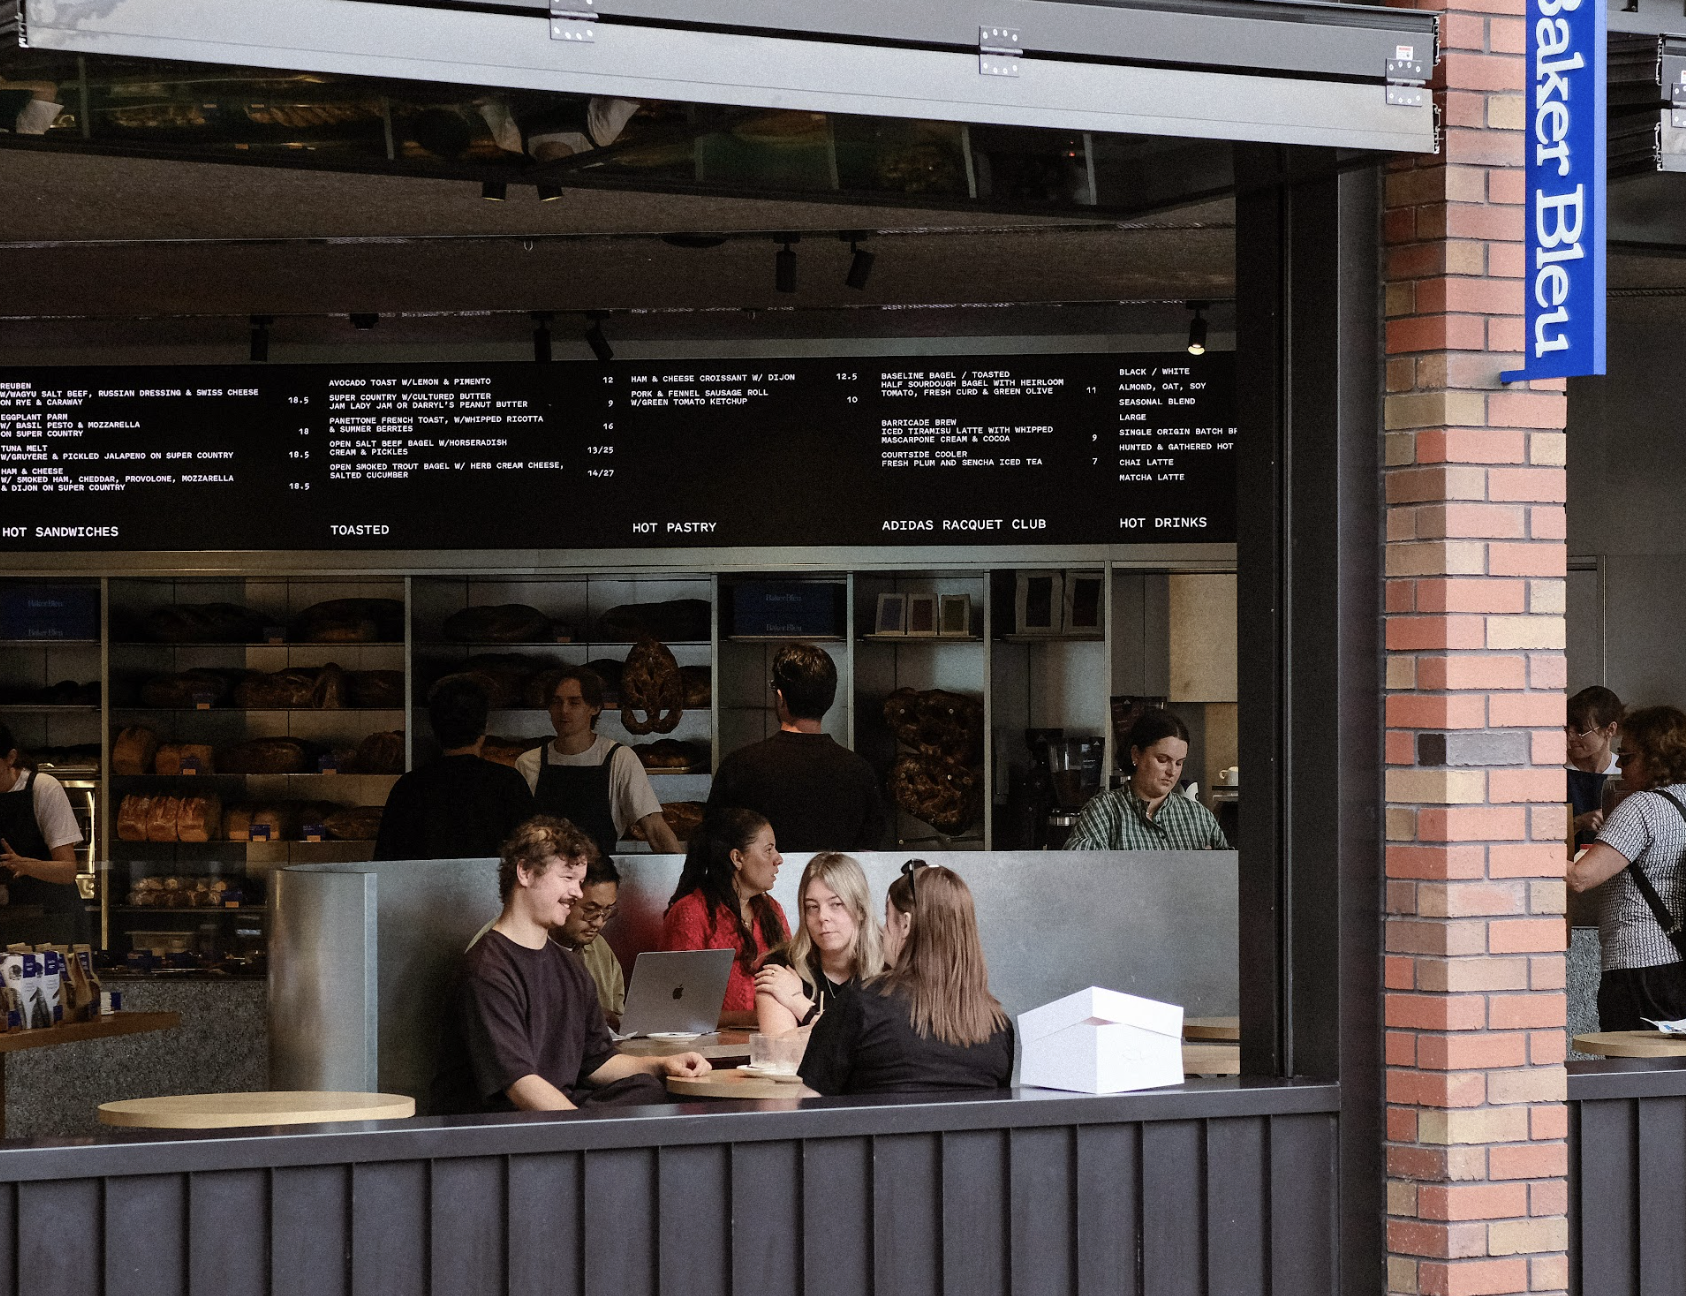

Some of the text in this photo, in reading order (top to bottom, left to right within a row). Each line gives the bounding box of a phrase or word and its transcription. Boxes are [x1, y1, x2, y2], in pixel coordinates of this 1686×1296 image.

[1535, 0, 1585, 358] aker Bleu
[962, 371, 967, 379] /
[1152, 368, 1157, 376] /
[700, 374, 747, 382] CROISSANT
[836, 373, 857, 381] 12.5
[0, 382, 32, 390] REUBEN
[139, 389, 181, 397] DRESSING
[1026, 387, 1053, 395] OLIVE
[288, 396, 308, 404] 18.5
[1119, 398, 1162, 406] SEASONAL
[882, 419, 929, 427] BARRICADE
[408, 439, 434, 447] BAGEL
[587, 446, 613, 454] 13/25
[289, 451, 309, 459] 18.5
[588, 469, 614, 477] 14/27
[289, 482, 309, 490] 18.5
[882, 519, 1046, 531] ADIDAS RACQUET CLUB
[1120, 517, 1207, 528] HOT DRINKS
[3, 526, 119, 537] HOT SANDWICHES
[330, 525, 389, 535] TOASTED
[633, 522, 716, 533] HOT PASTRY
